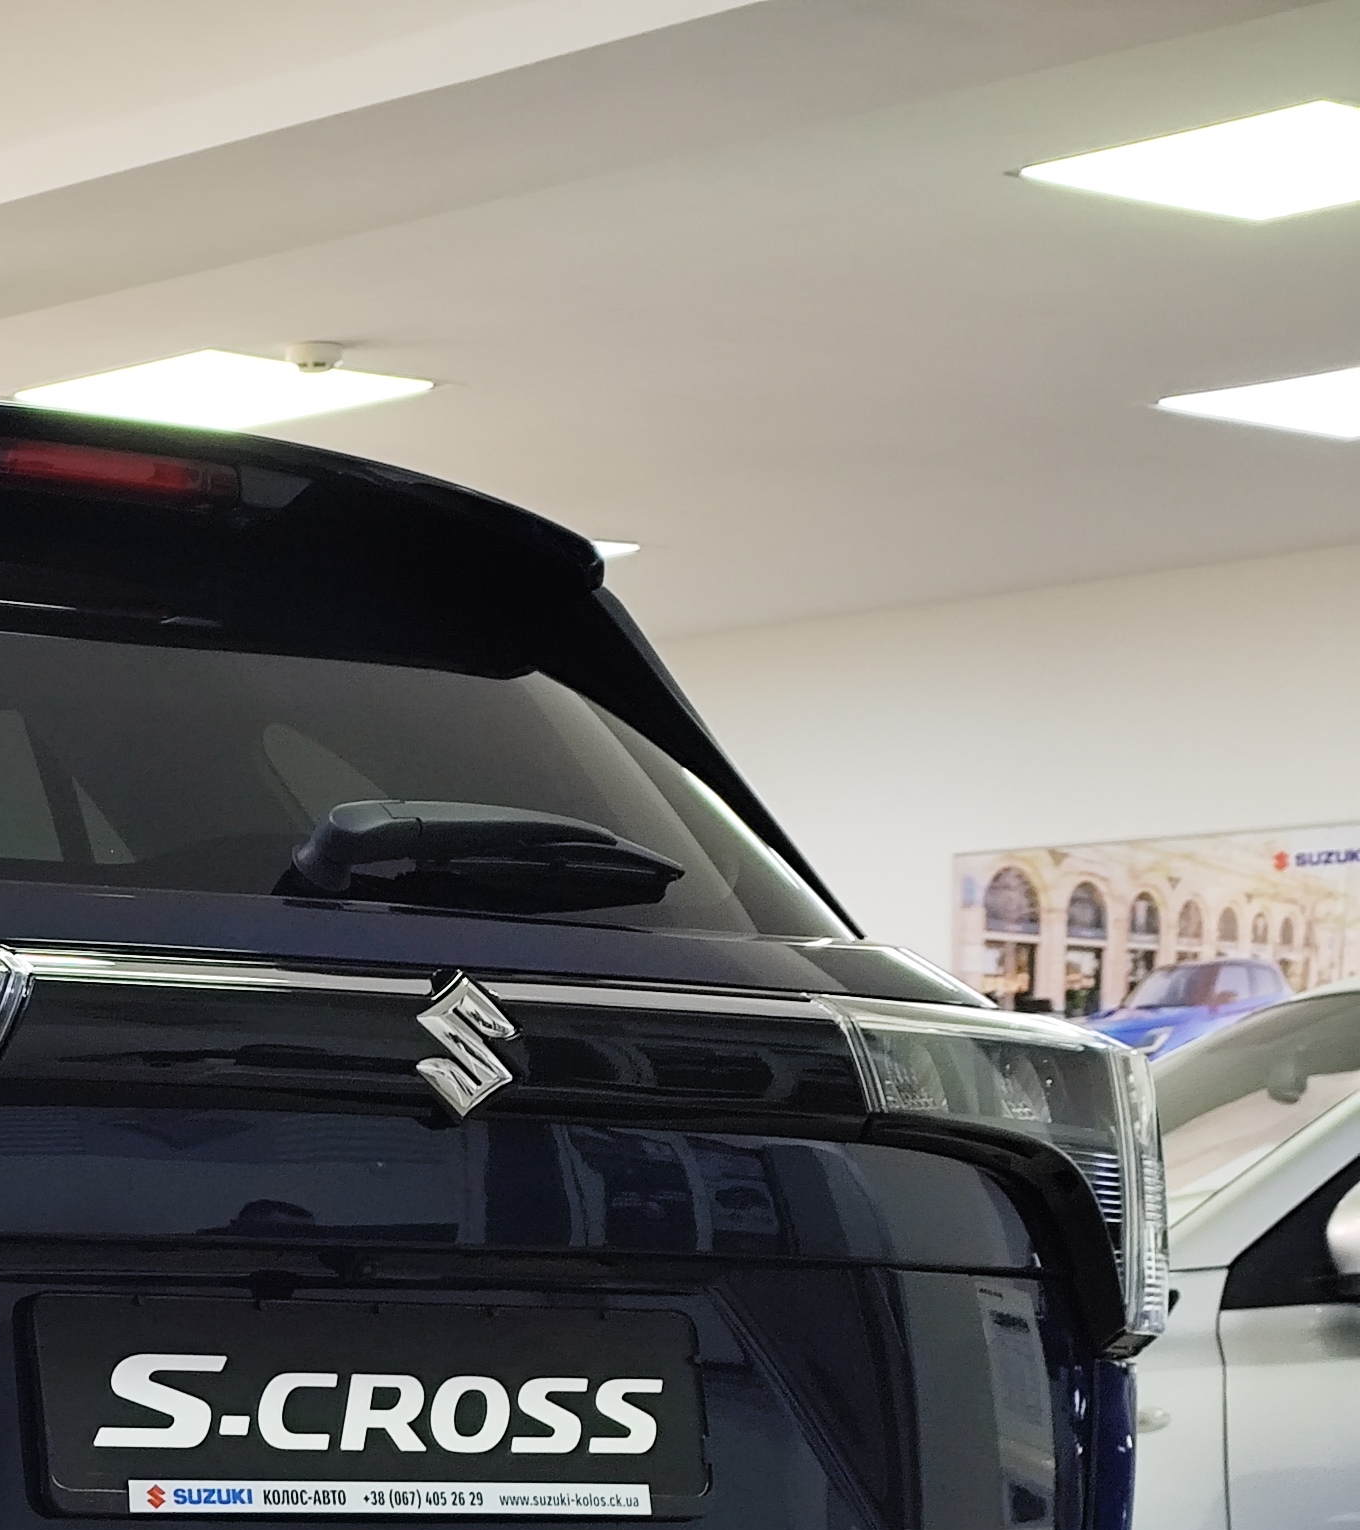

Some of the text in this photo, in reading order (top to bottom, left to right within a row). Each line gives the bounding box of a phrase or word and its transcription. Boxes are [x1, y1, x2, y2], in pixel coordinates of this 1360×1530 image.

[1295, 849, 1360, 867] SUZUK
[93, 1353, 664, 1454] S-CROSS
[173, 1488, 640, 1509] SUZUKI КОЛОС-АВТО +38 (067) 405 26 29 www.suzuki-kolos.ck.ua
